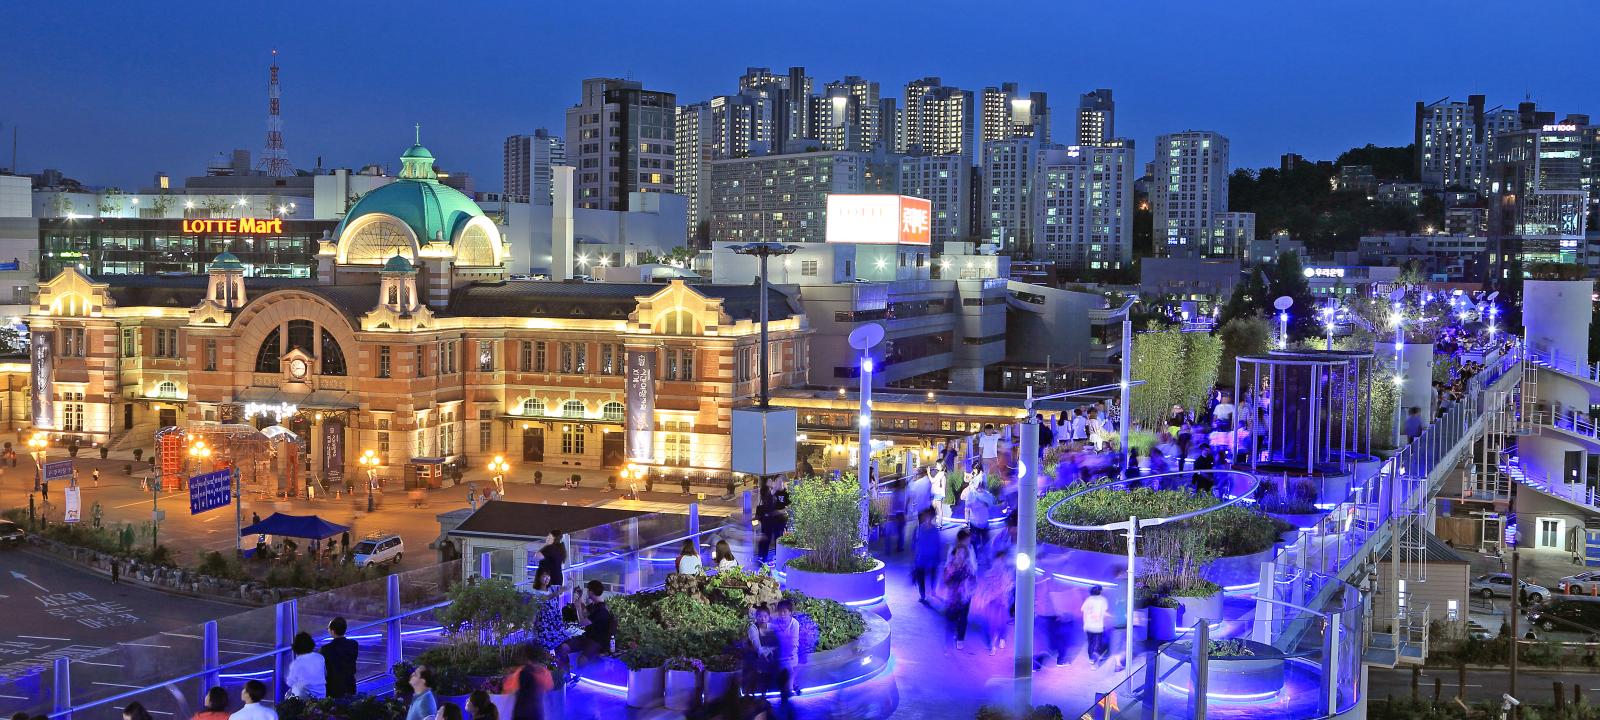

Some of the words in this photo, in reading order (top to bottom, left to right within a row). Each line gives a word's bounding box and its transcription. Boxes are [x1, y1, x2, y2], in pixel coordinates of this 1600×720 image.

[1542, 124, 1576, 132] SKY1004
[183, 219, 237, 233] LOTTE
[239, 217, 282, 234] Mart
[1315, 268, 1345, 277] 우리은행
